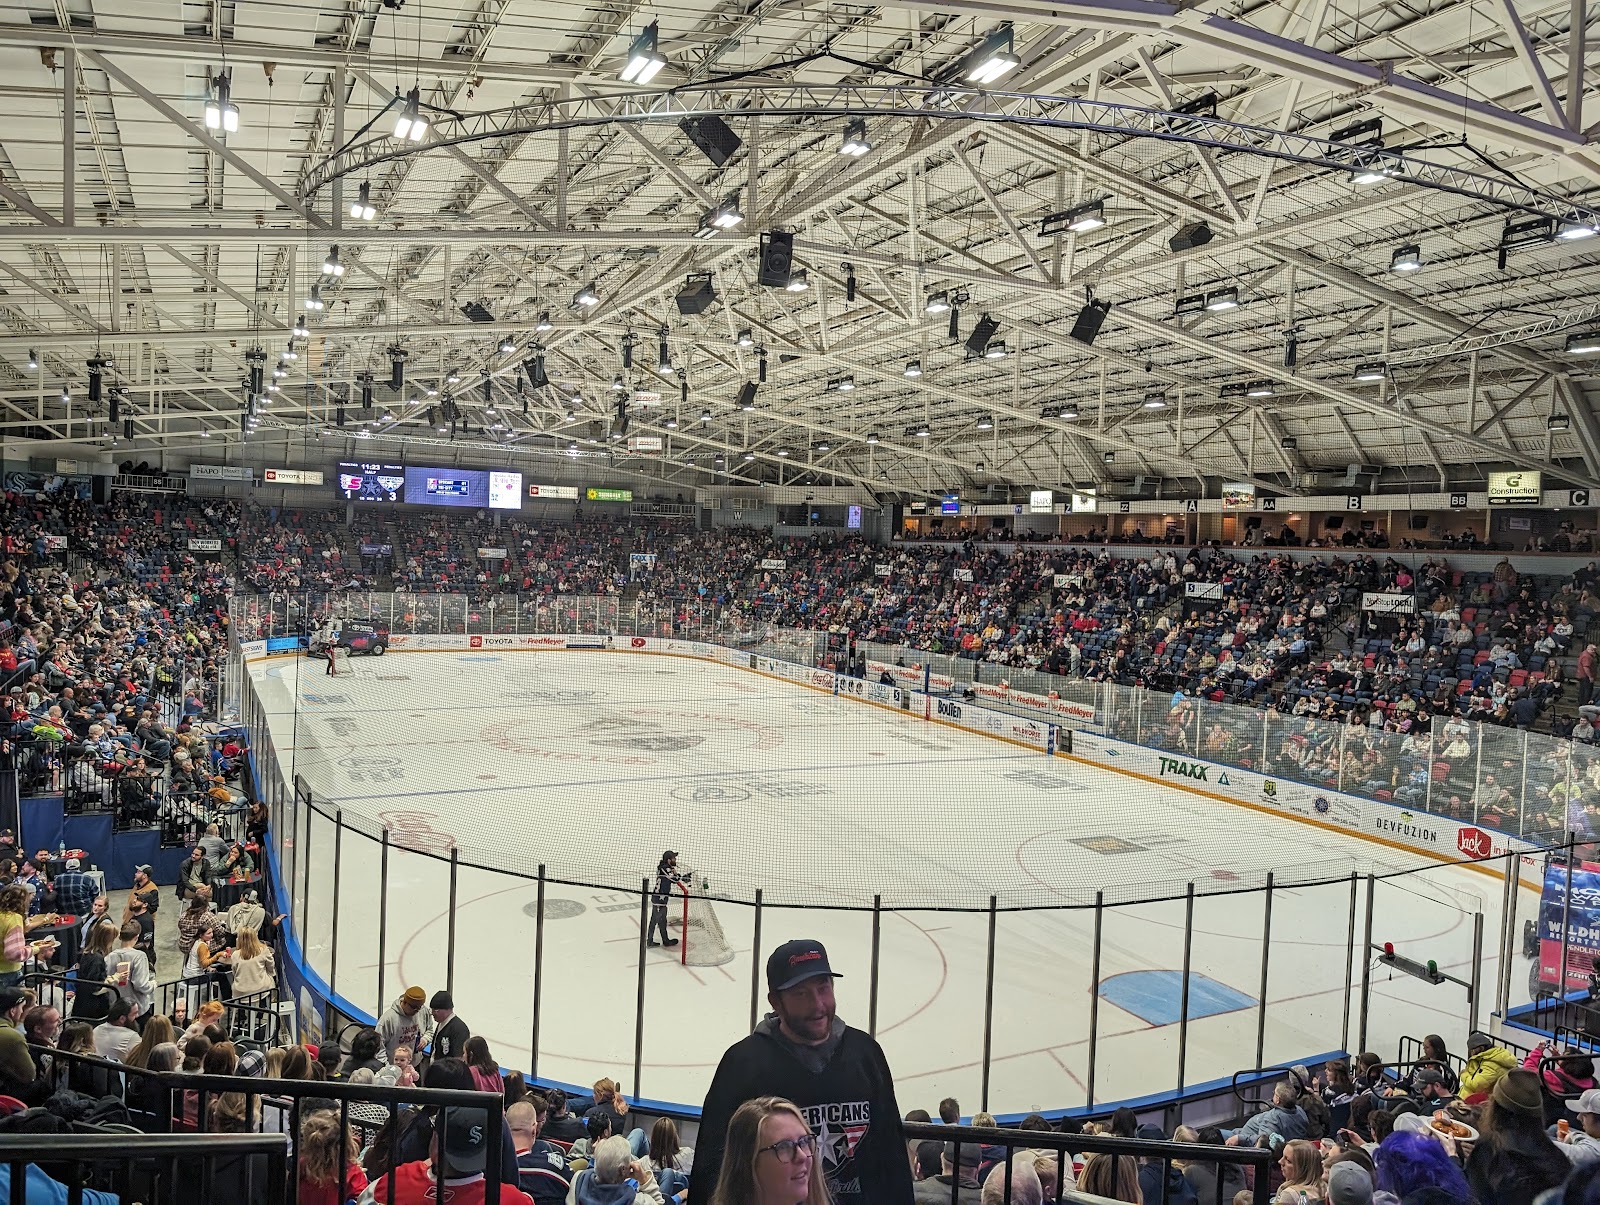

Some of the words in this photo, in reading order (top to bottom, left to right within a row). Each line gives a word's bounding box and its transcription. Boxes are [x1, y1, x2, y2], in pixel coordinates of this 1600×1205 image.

[345, 490, 352, 499] 1
[1490, 486, 1538, 494] Construction
[389, 492, 397, 501] 3
[1451, 496, 1466, 505] BB
[1572, 490, 1586, 506] C
[1188, 500, 1197, 512] A
[1263, 500, 1275, 510] AA
[1349, 496, 1359, 510] B
[734, 512, 742, 520] W
[1012, 726, 1041, 738] WILDHORSE
[1158, 756, 1210, 782] TRAXX
[1376, 818, 1437, 843] DEVFUZION
[1458, 830, 1489, 858] Jack
